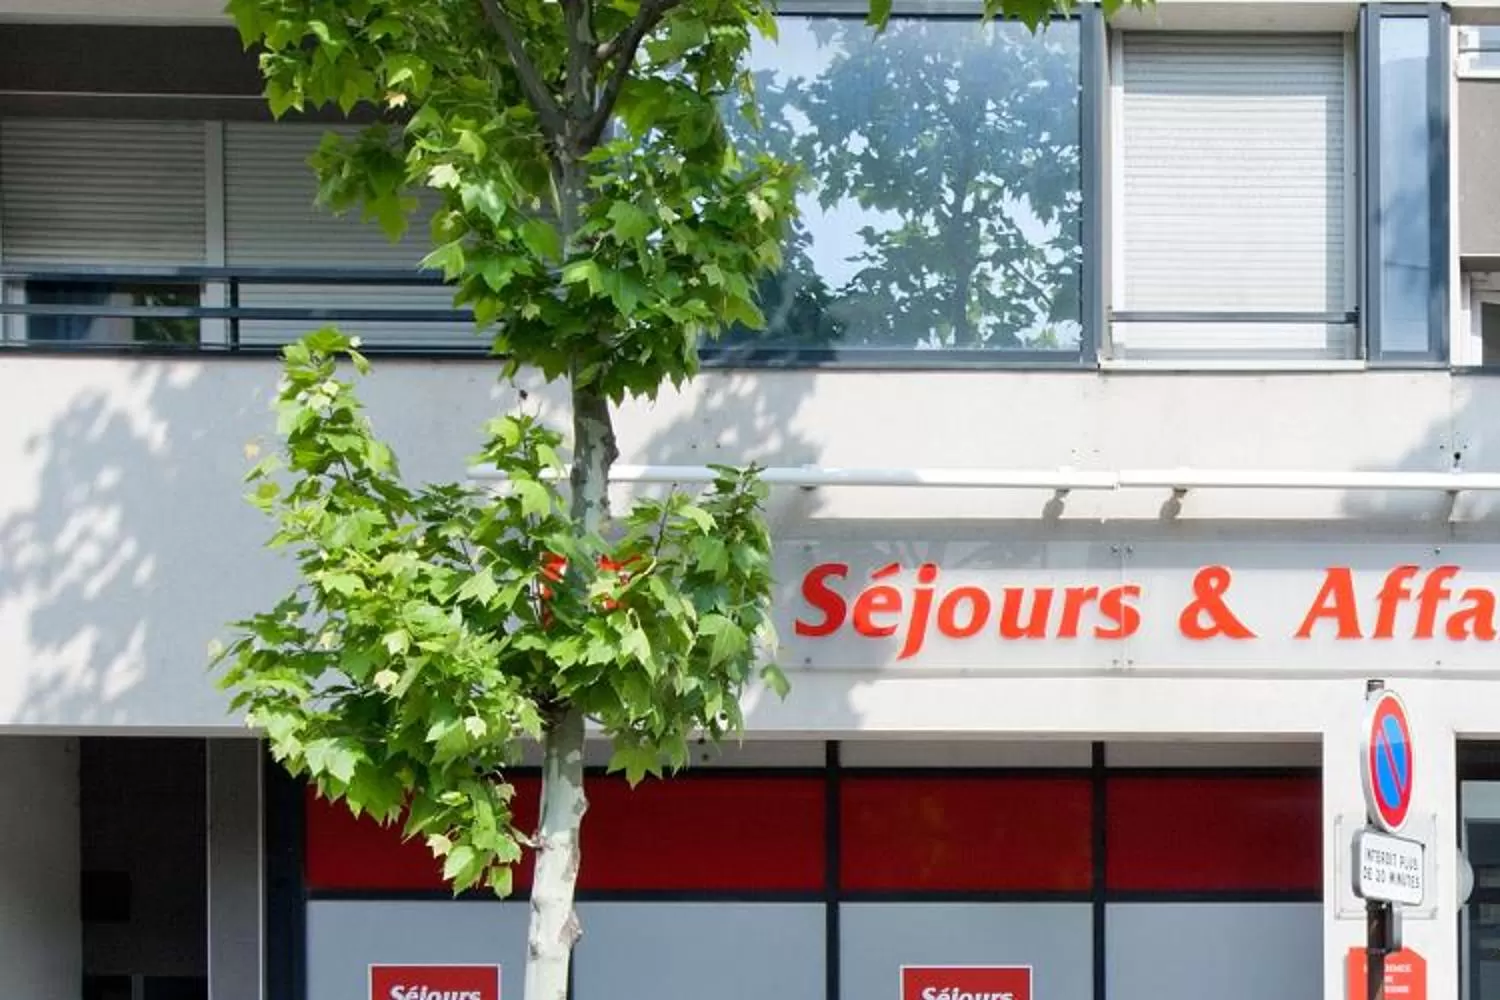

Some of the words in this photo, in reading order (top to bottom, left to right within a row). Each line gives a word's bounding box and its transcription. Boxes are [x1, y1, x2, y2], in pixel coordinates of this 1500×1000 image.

[795, 561, 1141, 660] Séjours
[1179, 565, 1258, 640] &
[1364, 847, 1397, 868] INTERDIT
[1399, 855, 1419, 871] PLUS
[1363, 865, 1373, 881] DE
[1389, 871, 1420, 889] MINUTES
